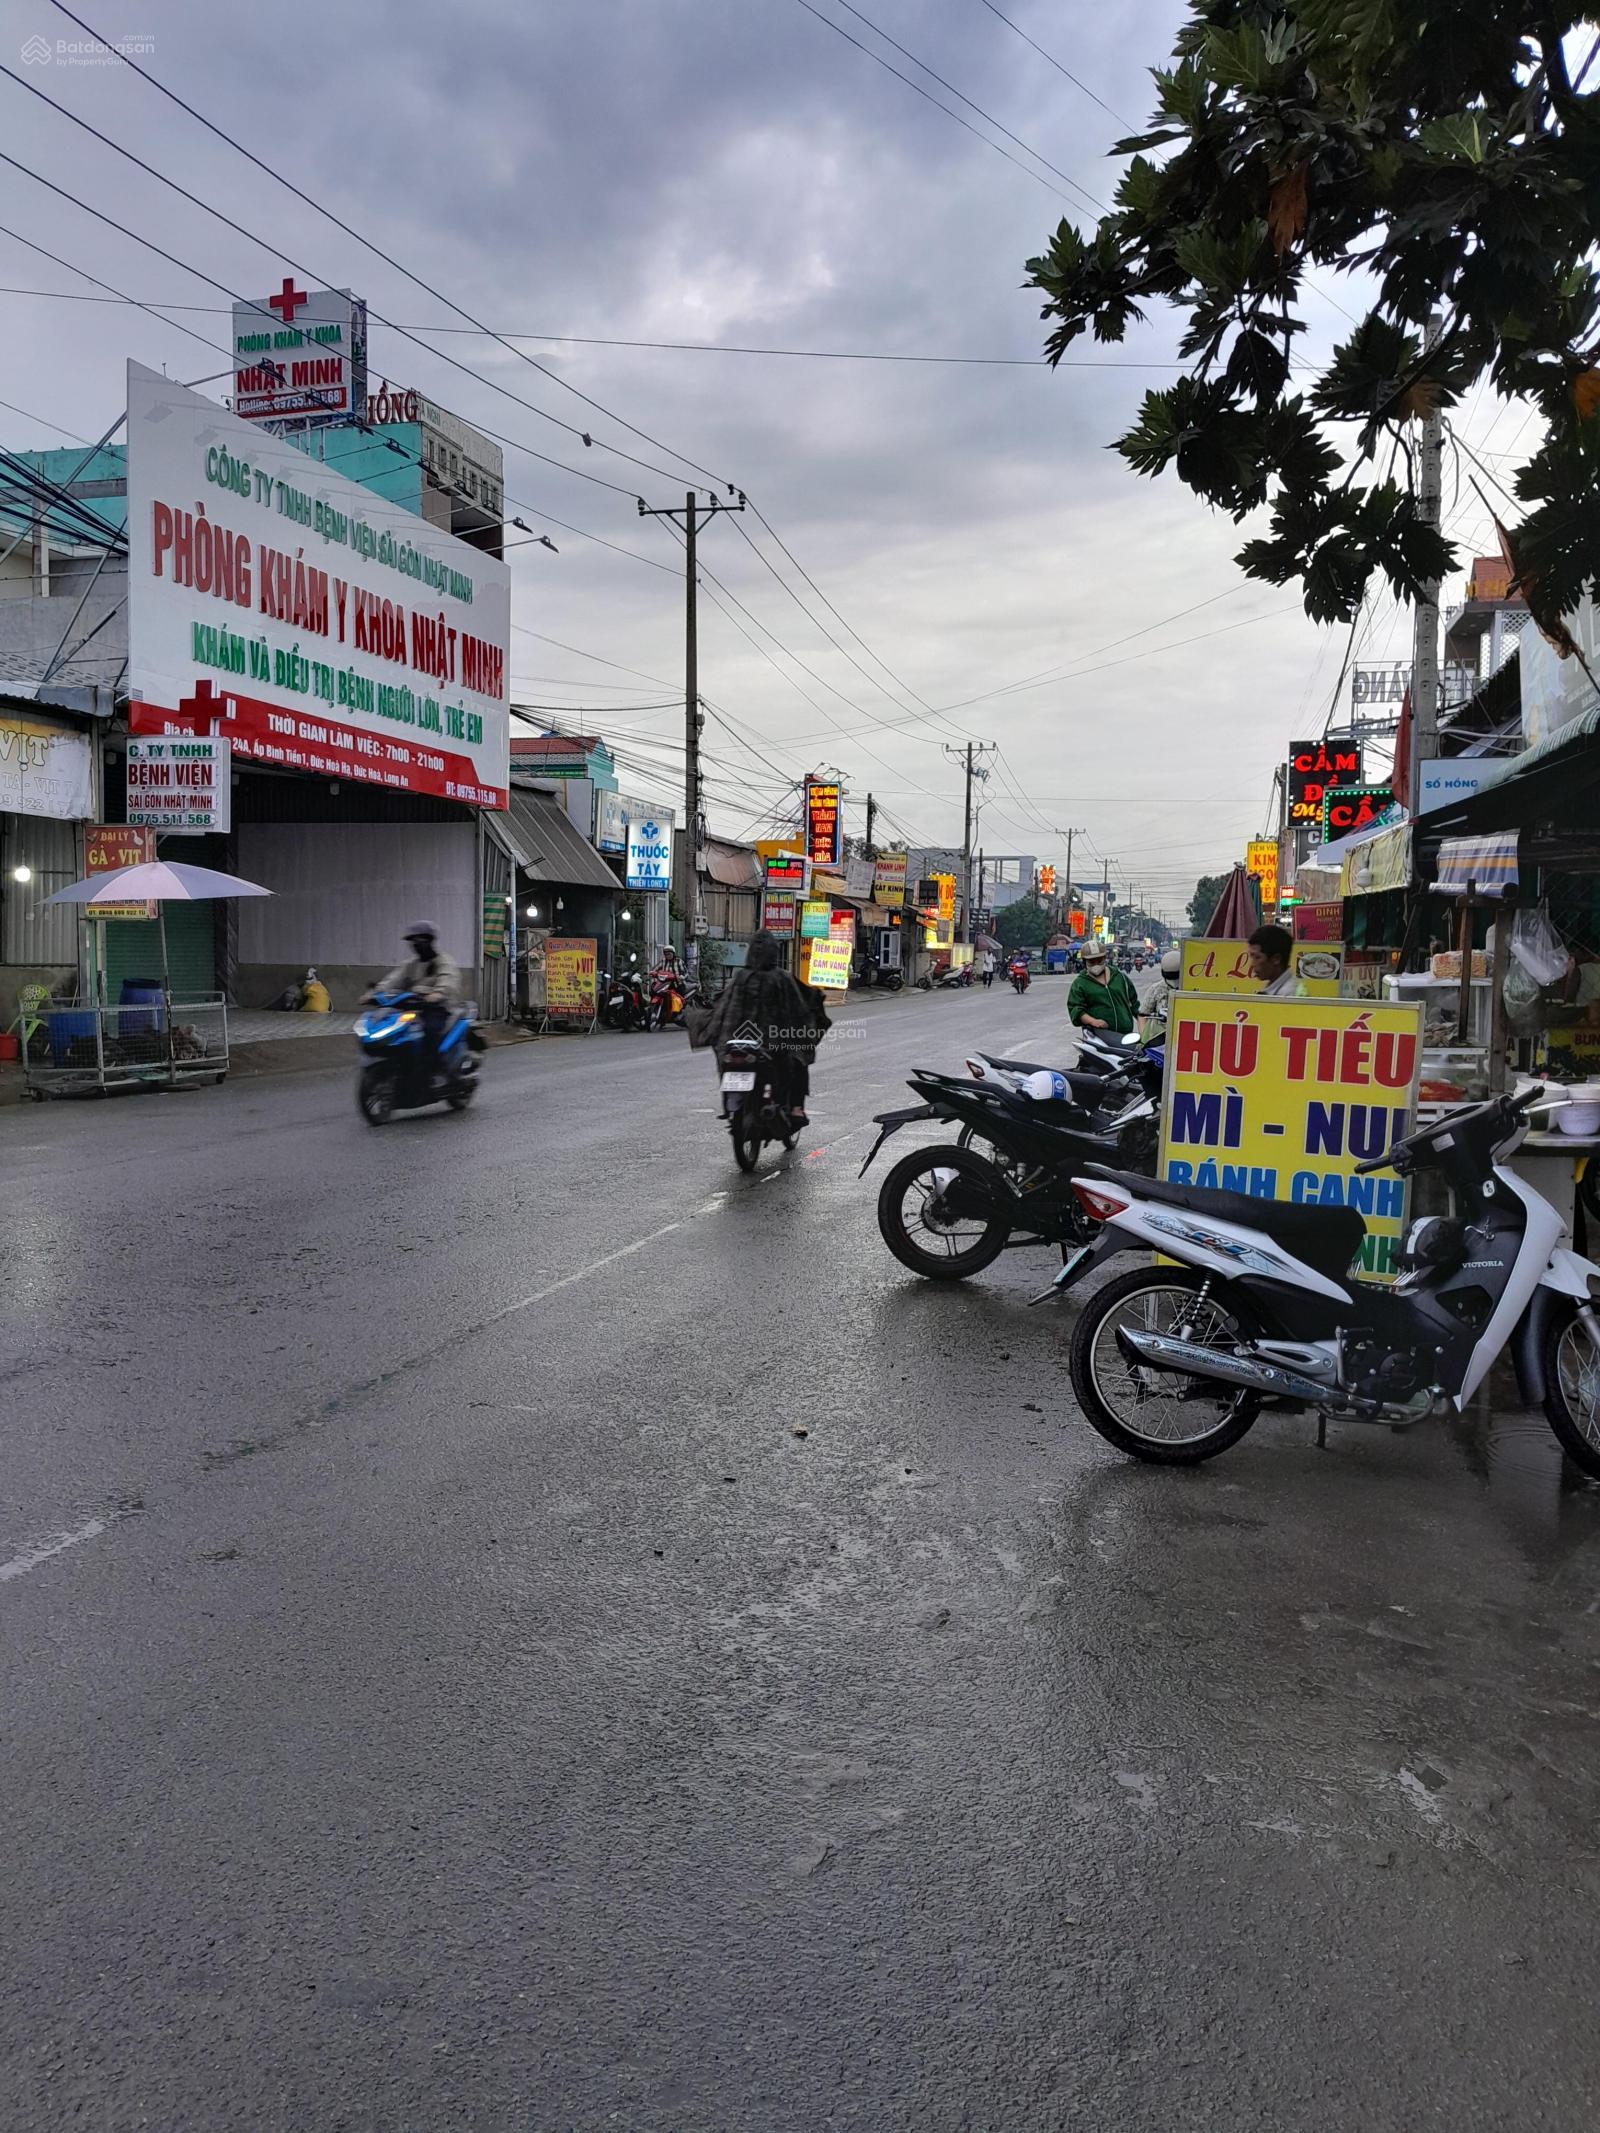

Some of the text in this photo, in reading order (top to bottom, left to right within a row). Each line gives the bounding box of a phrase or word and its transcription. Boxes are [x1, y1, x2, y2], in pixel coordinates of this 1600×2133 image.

[237, 331, 271, 353] PHÒNG
[306, 328, 313, 348] Y
[315, 324, 342, 344] KHOA
[291, 357, 343, 387] MINH
[206, 443, 473, 605] CÔNG TY TNHH BỆNH VIỆN SÀI GÒN NHẬT MINH
[153, 500, 503, 700] PHÒNG KHÁM Y KHOA NHẬT MINH
[191, 622, 483, 744] KHÁM VÀ ĐIỀU TRỊ BỆNH NGƯỜI LỚN, TRẺ EM
[164, 721, 195, 736] Địa ch
[267, 713, 296, 737] THỜI
[299, 721, 327, 745] GIAN
[329, 727, 354, 751] LÀM
[356, 734, 384, 758] VIỆC:
[385, 744, 410, 764] 7h00
[417, 752, 445, 772] 21h00
[0, 728, 49, 771] VỊT
[128, 744, 212, 757] C. TY TNHH
[232, 739, 252, 754] 24A,
[253, 738, 265, 757] Ấp
[310, 754, 325, 769] Đức
[353, 764, 367, 778] Đức
[384, 771, 399, 786] Long
[400, 775, 409, 787] An
[1294, 744, 1356, 772] CẦM
[128, 760, 212, 790] BỆNH VIỆN
[145, 791, 161, 808] GÒN
[164, 791, 187, 812] NHẬT
[190, 795, 212, 808] MINH
[1329, 795, 1387, 827] CẦ
[129, 813, 211, 825] 0975.511.568
[88, 845, 109, 865] GÀ
[630, 841, 669, 859] THUỐC
[1254, 854, 1276, 865] KIM
[637, 861, 660, 876] TÂY
[1175, 1010, 1417, 1089] HỦ TIẾU
[1170, 1086, 1244, 1148] MÌ
[1262, 1123, 1285, 1135] -
[1290, 1171, 1406, 1218] CANH
[1462, 1260, 1504, 1269] VICTORIA
